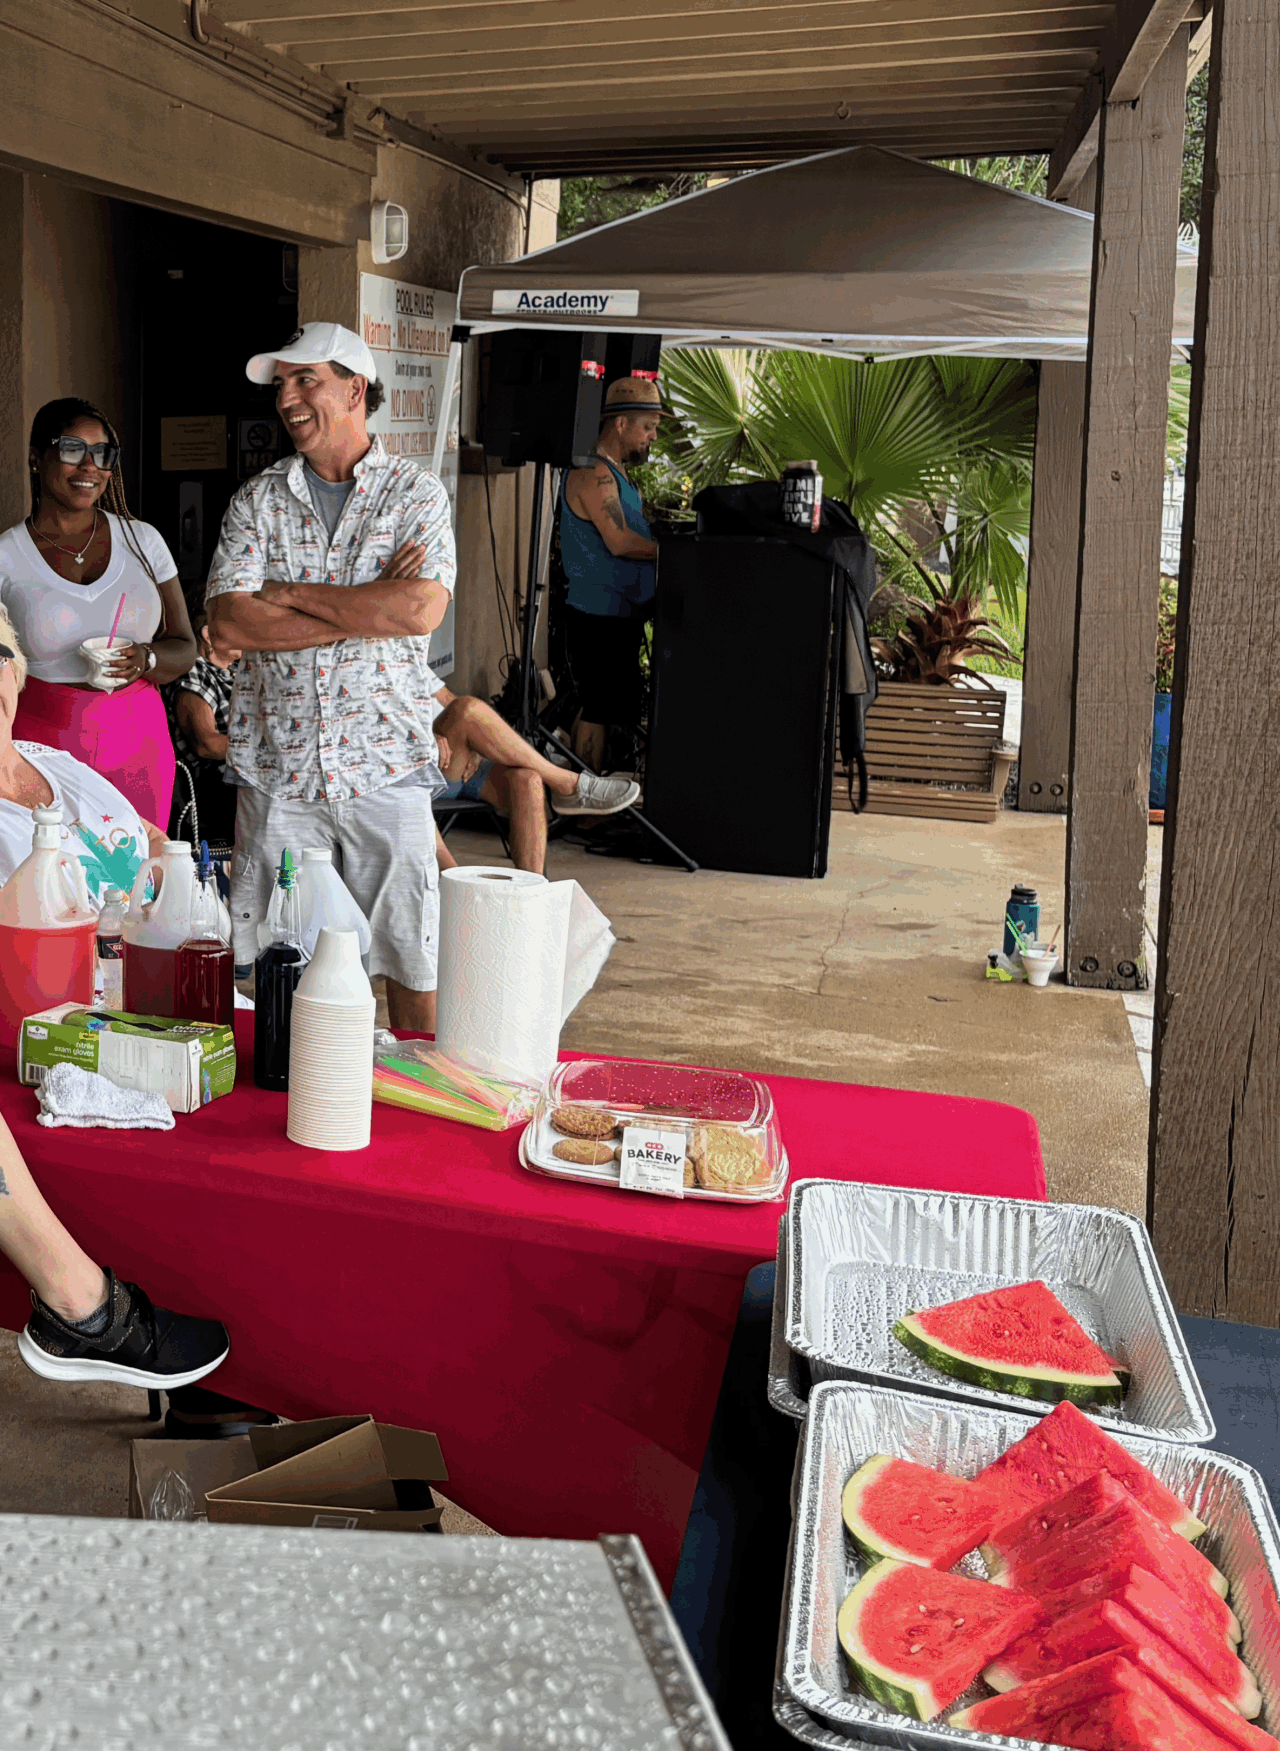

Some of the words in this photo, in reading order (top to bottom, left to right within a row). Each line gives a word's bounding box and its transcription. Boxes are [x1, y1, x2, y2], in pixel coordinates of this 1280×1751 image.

[396, 288, 413, 313] POOL
[414, 292, 434, 317] RULES
[517, 291, 609, 313] Academy
[364, 313, 392, 351] Warning
[391, 389, 401, 418] NO
[402, 389, 424, 418] DIVING
[54, 1045, 72, 1054] exam
[73, 1048, 95, 1057] gloves
[75, 1042, 95, 1050] nitrile
[627, 1149, 682, 1165] BAKERY
